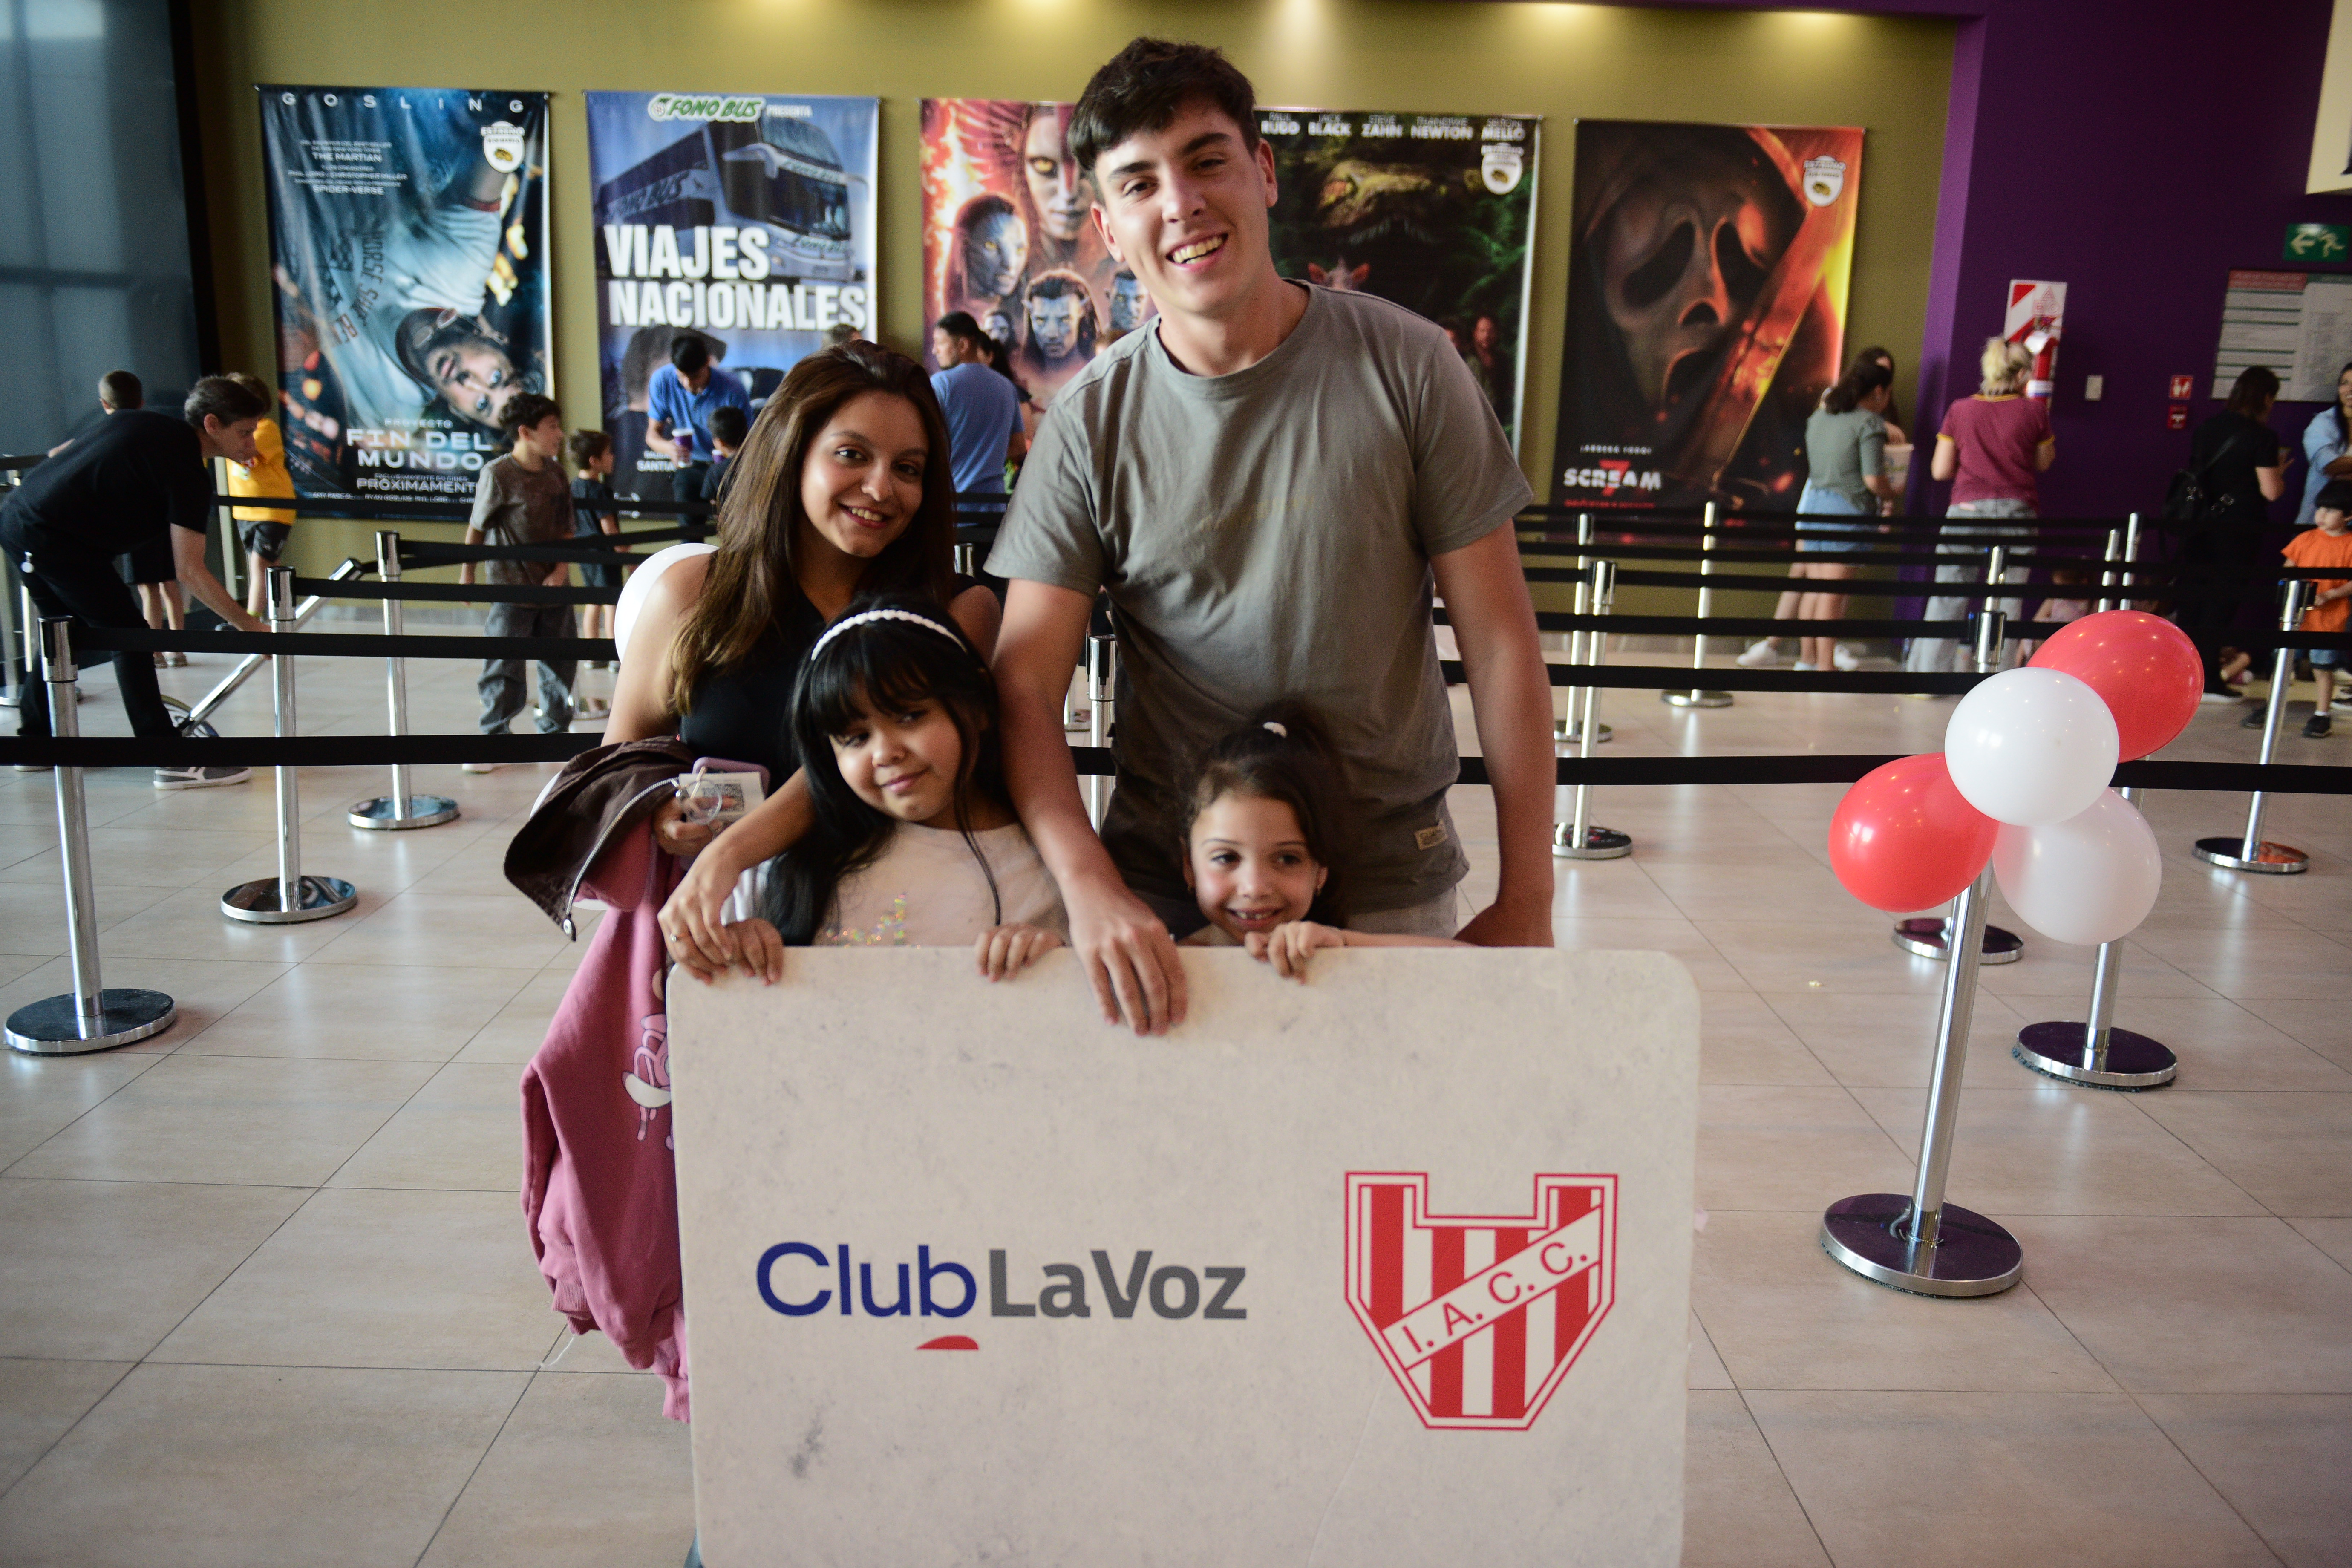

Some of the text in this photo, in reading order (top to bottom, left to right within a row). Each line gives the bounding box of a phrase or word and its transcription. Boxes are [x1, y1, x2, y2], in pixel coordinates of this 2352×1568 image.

[282, 92, 524, 113] GOSLING
[668, 98, 761, 118] FONO BUS
[1261, 120, 1300, 135] RUDD
[1308, 122, 1352, 136] BLACK
[1361, 123, 1403, 138] ZAHN
[1410, 125, 1473, 140] NEWTON
[1481, 127, 1525, 141] MELLO
[335, 153, 383, 162] MARTIAN
[603, 224, 770, 281] VIAJES
[608, 280, 868, 331] NACIONALES
[384, 418, 453, 429] PROYECTO
[346, 428, 493, 451] FIN DEL
[358, 449, 484, 471] MUNDO
[637, 460, 677, 472] SANTIA
[1563, 468, 1662, 492] SCREAM
[756, 1241, 977, 1319] Club
